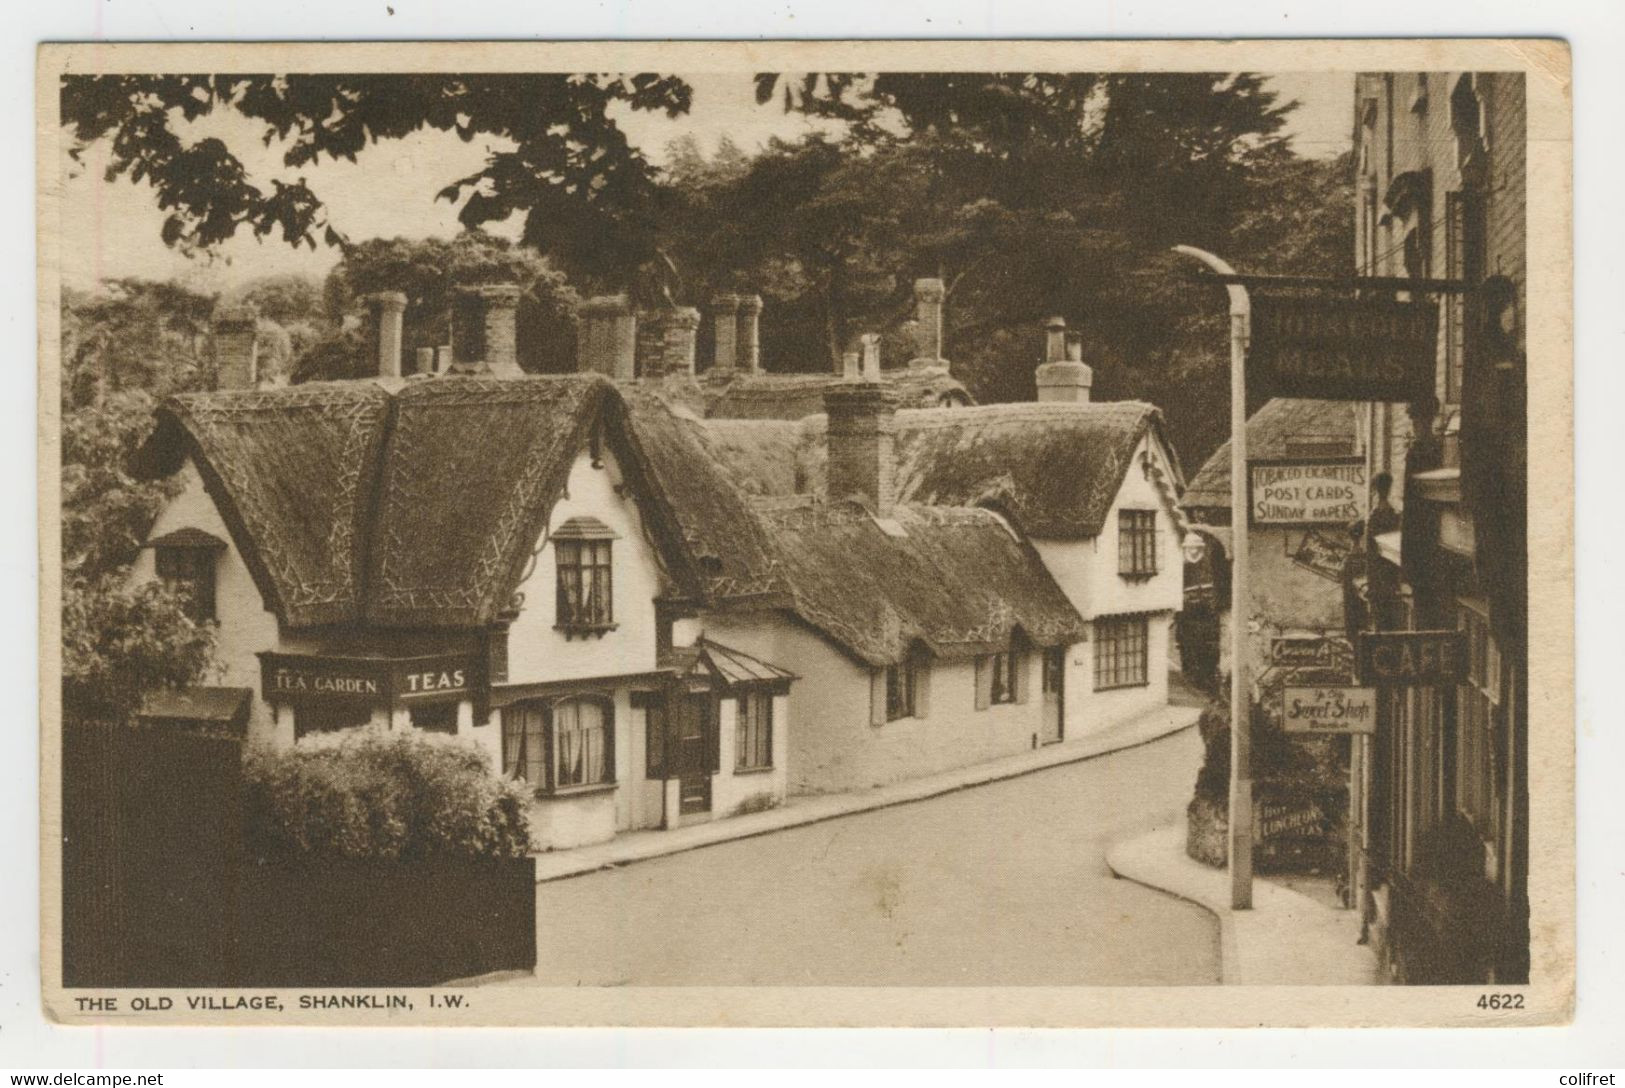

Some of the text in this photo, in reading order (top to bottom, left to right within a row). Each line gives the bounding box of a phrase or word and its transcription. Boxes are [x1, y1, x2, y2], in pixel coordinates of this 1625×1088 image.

[1276, 348, 1405, 381] MEALS
[1264, 486, 1354, 500] POST CARDS
[1257, 501, 1359, 519] SUNDAY PAPERS
[276, 672, 377, 693] TEA GARDEN
[407, 669, 465, 691] TEAS
[1331, 699, 1370, 722] Shop
[76, 995, 468, 1011] THE OLD VILLAGE, SHANKLIN, I.W.
[1477, 994, 1524, 1009] 4622
